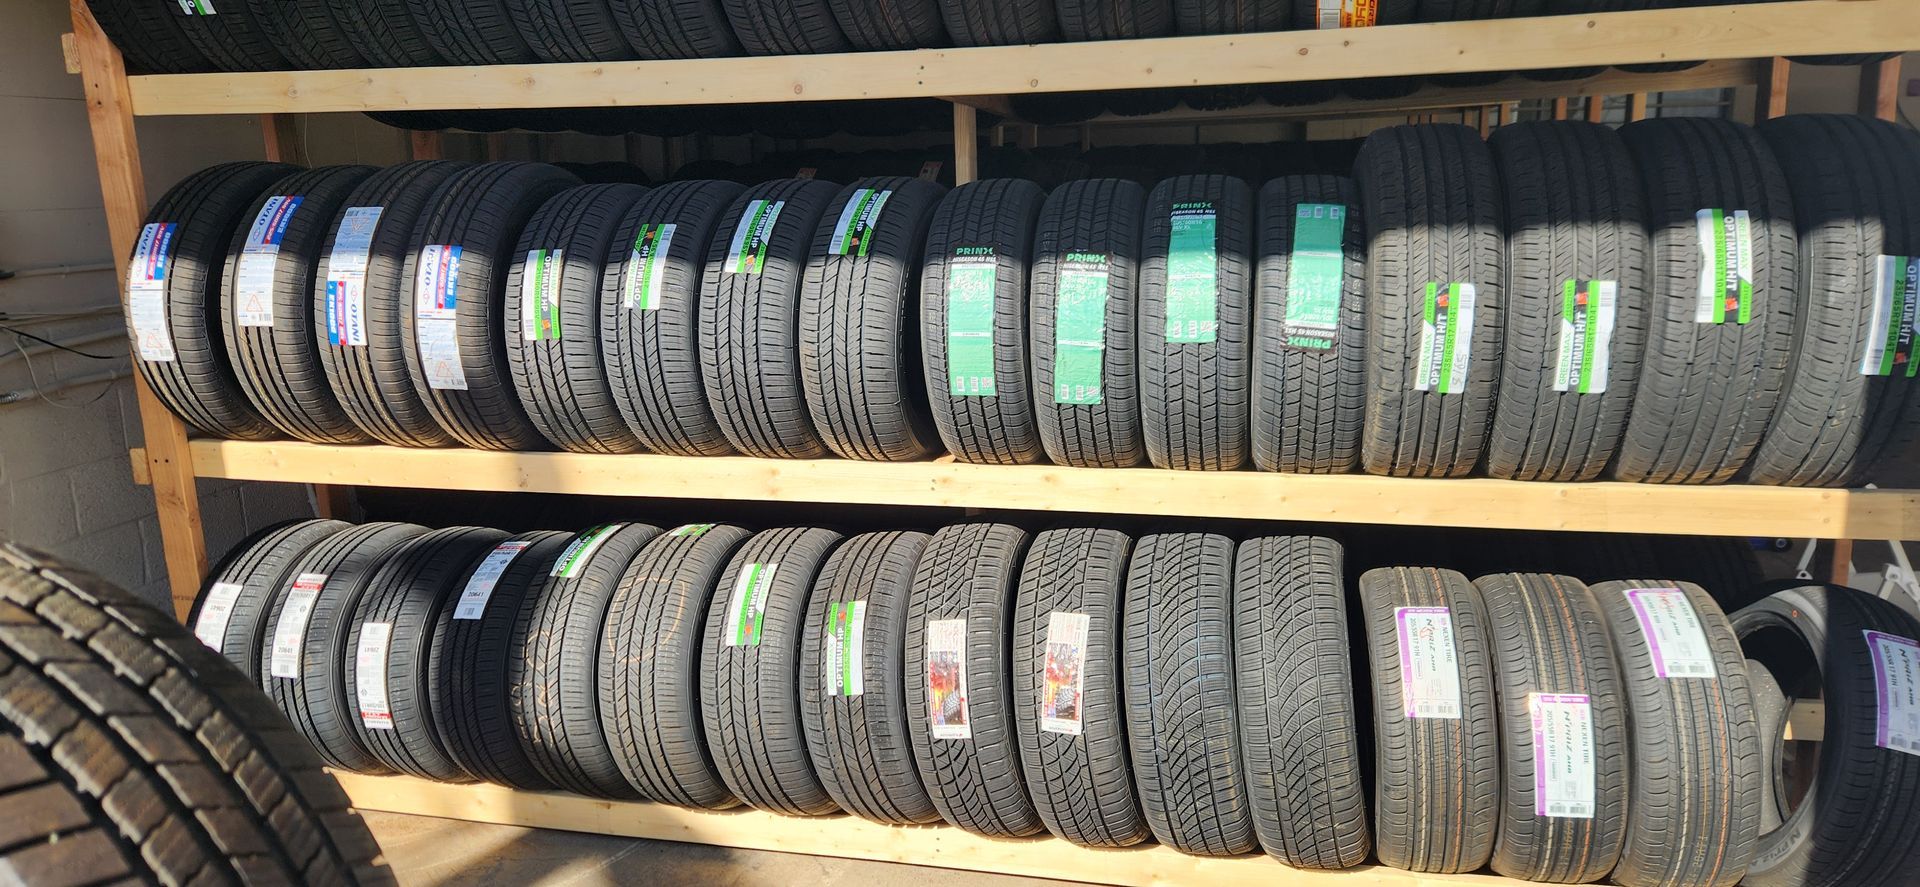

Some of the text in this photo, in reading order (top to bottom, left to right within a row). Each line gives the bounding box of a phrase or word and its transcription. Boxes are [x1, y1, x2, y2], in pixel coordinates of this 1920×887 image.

[258, 195, 279, 225] OTANI
[753, 203, 773, 236] OPTIMUM
[859, 192, 880, 221] OPTIMUM
[136, 225, 153, 259] OTANI
[749, 236, 759, 248] HP
[854, 220, 864, 232] HP
[1066, 254, 1105, 262] PRINX
[1723, 215, 1736, 290] OPTIMUM H/T
[541, 255, 551, 311] OPTIMUM HP
[633, 257, 646, 300] OPTIMUM
[640, 244, 649, 257] HP
[1890, 279, 1903, 328] 235/65R17
[1902, 265, 1917, 321] OPTIMUM
[351, 303, 359, 342] OTANI
[1435, 313, 1447, 333] H/T
[1898, 323, 1911, 344] H/T
[1287, 335, 1331, 348] PRINX
[1443, 329, 1454, 372] 235/65R17
[1569, 310, 1587, 385] OPTIMUM H/T
[1583, 327, 1595, 371] 235/65R17
[1429, 333, 1445, 385] OPTIMUM
[748, 568, 765, 605] OPTIMUM
[747, 606, 754, 618] HP
[837, 627, 844, 639] HP
[1440, 626, 1452, 663] NEXEN TIRE
[1580, 721, 1588, 746] NEXEN
